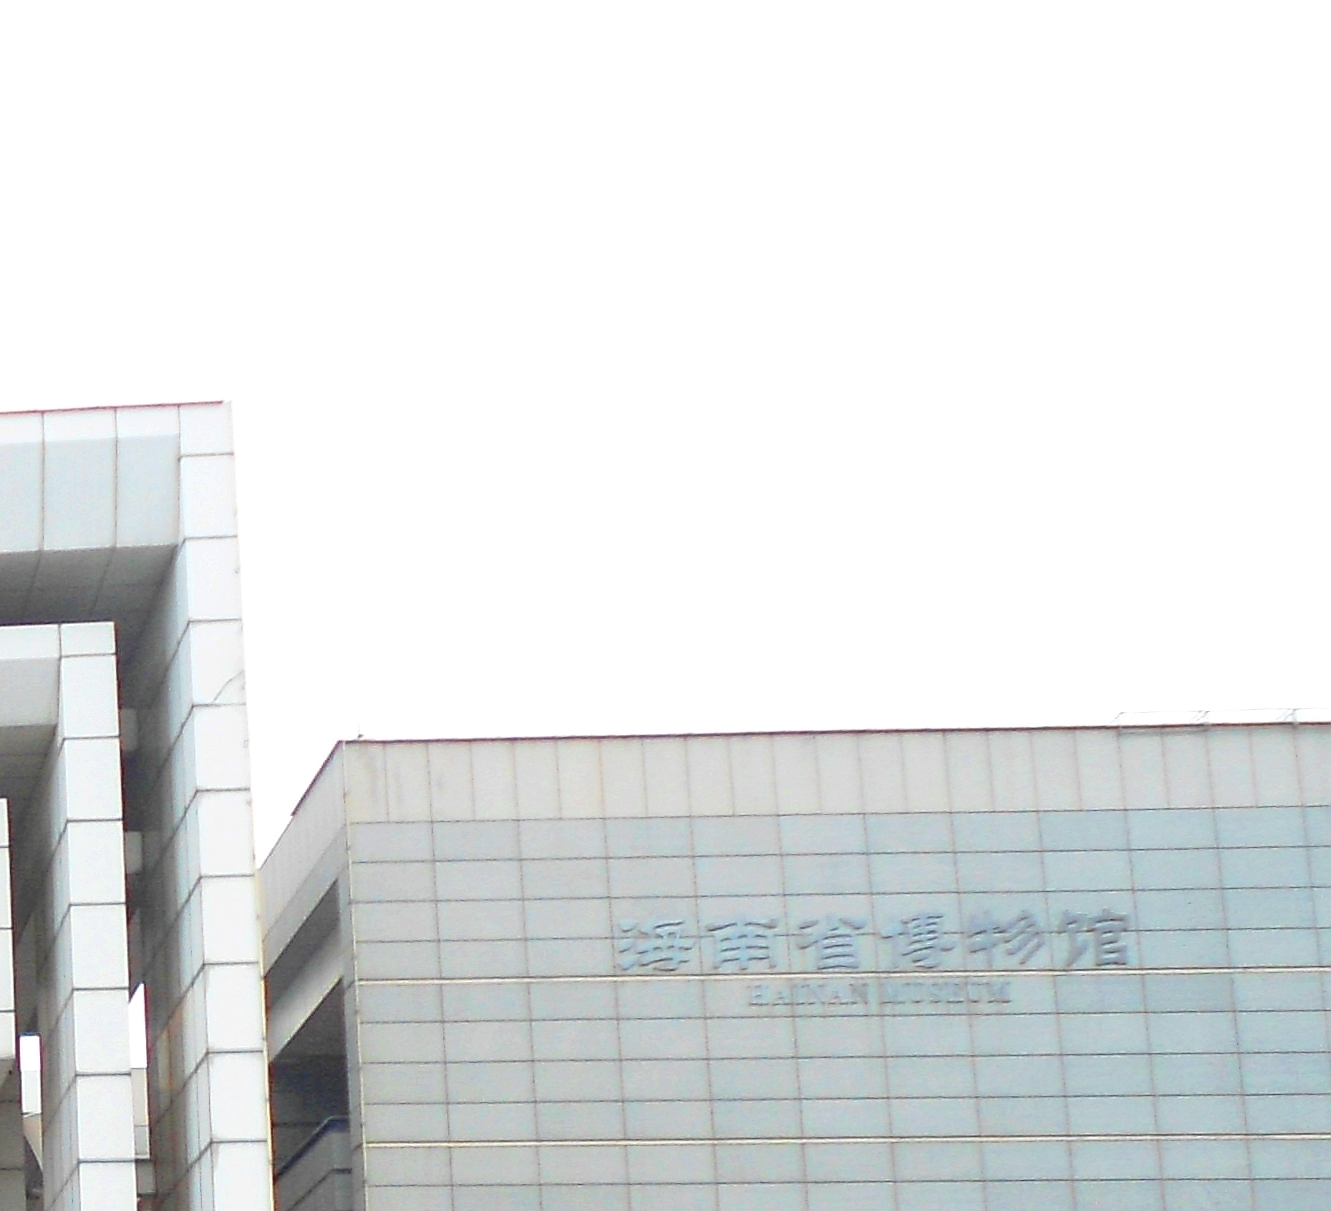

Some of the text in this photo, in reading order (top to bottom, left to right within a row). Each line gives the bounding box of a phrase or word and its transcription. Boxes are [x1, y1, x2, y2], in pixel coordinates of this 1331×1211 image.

[618, 909, 1129, 972] 海南省博物馆
